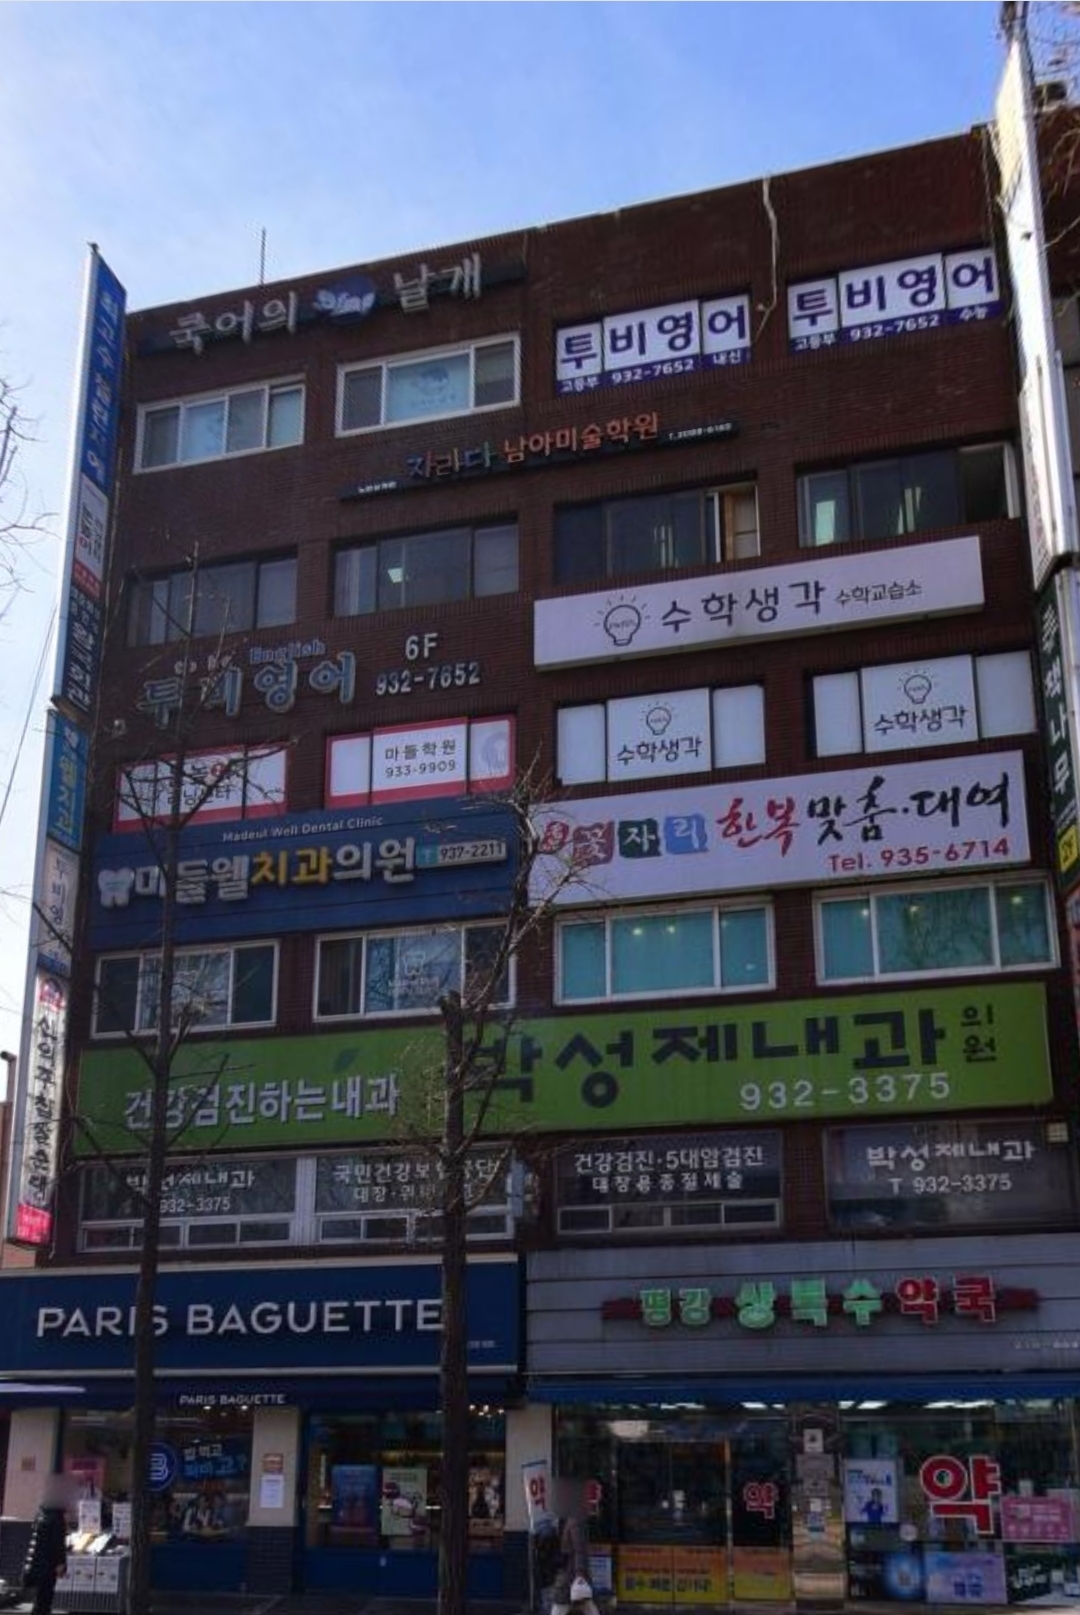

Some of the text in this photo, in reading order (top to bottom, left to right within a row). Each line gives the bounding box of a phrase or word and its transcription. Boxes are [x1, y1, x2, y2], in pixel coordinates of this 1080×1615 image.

[393, 252, 482, 314] 날개
[792, 256, 995, 326] 투비영어
[560, 303, 747, 370] 투비영어
[849, 313, 941, 343] 932-7652
[610, 357, 697, 386] 932-7652
[660, 578, 922, 633] 수학생각 수학교습소
[404, 632, 440, 662] 6F
[374, 660, 482, 698] 932-7652
[873, 703, 968, 737] 수학생각
[615, 735, 703, 768] 수학생각
[384, 758, 457, 780] 933-9909
[302, 819, 344, 836] Dental
[348, 815, 384, 831] Clinic
[714, 796, 798, 857] 한복
[880, 837, 1009, 868] 935-6714
[464, 1008, 946, 1110] 박성제내과
[738, 1071, 951, 1111] 932-3375
[865, 1140, 1036, 1172] 박성제내과
[911, 1173, 1012, 1195] 932-3375
[37, 1299, 447, 1338] PARIS BAGUETTE
[179, 1394, 285, 1405] PARIS BAGUETTE
[921, 1454, 1002, 1535] 약
